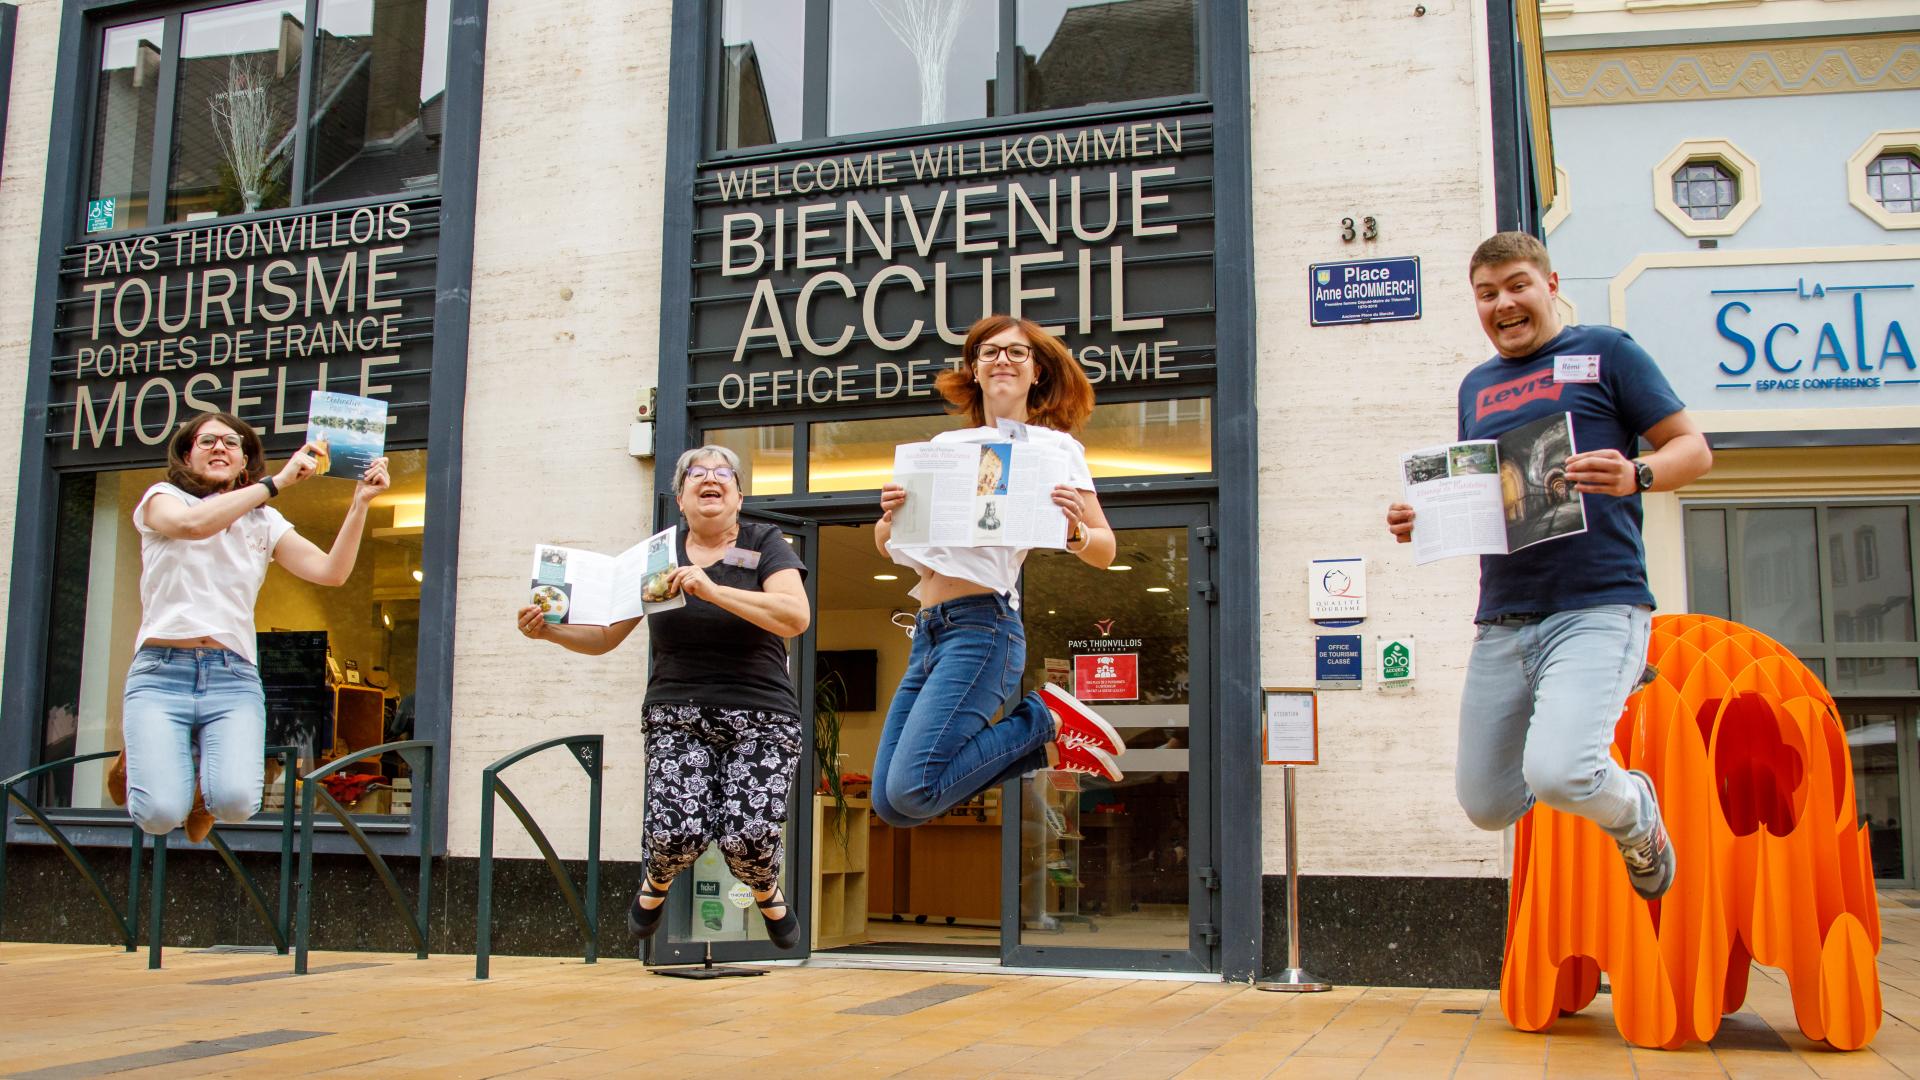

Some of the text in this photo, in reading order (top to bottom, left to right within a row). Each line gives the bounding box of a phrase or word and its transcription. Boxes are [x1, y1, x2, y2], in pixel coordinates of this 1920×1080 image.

[717, 120, 1182, 202] WELCOME WILLKOMMEN
[85, 203, 411, 278] PAYS THIONVILLOIS
[721, 167, 1178, 277] BIENVENUE
[83, 246, 404, 340] TOURISME
[1315, 280, 1415, 302] Anne GROMMERCH
[1344, 267, 1390, 282] Place
[1799, 278, 1825, 298] LA
[732, 246, 1164, 362] ACCUEIL
[77, 314, 402, 379] PORTES DE FRANCE
[719, 364, 859, 409] OFFICE
[875, 360, 931, 399] DE
[1756, 376, 1881, 391] ESPACE CONFÉRENCE
[1068, 638, 1142, 648] PAYS THIONVILLOIS
